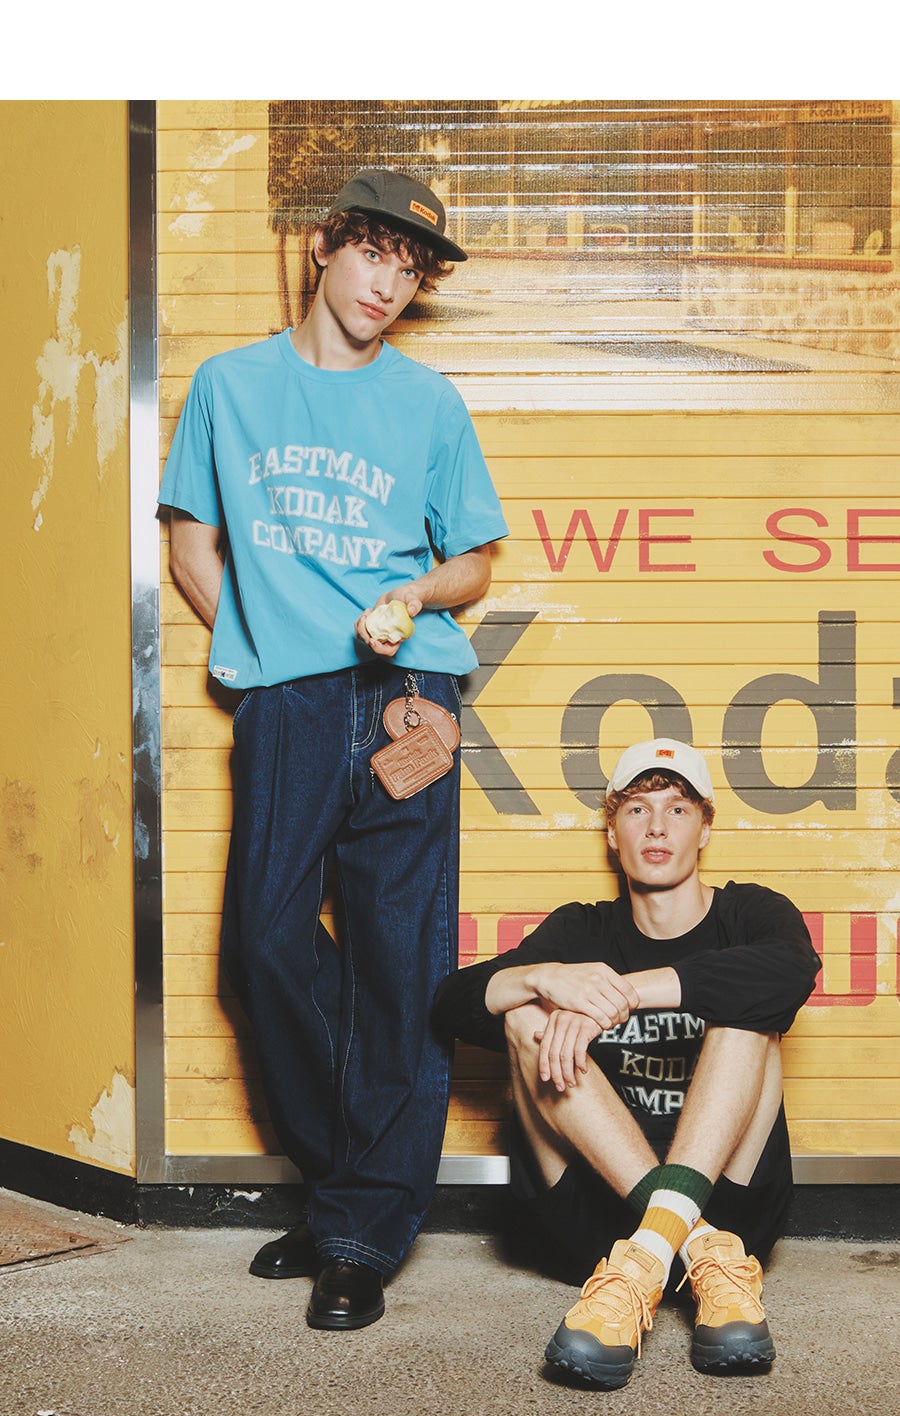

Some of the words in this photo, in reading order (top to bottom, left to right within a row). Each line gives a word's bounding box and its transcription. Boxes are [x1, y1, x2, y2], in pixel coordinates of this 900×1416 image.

[248, 444, 396, 507] EASTMAN
[266, 485, 369, 529] KODAK
[252, 519, 388, 569] COMPANY
[531, 508, 697, 573] WE
[461, 609, 900, 816] Kod
